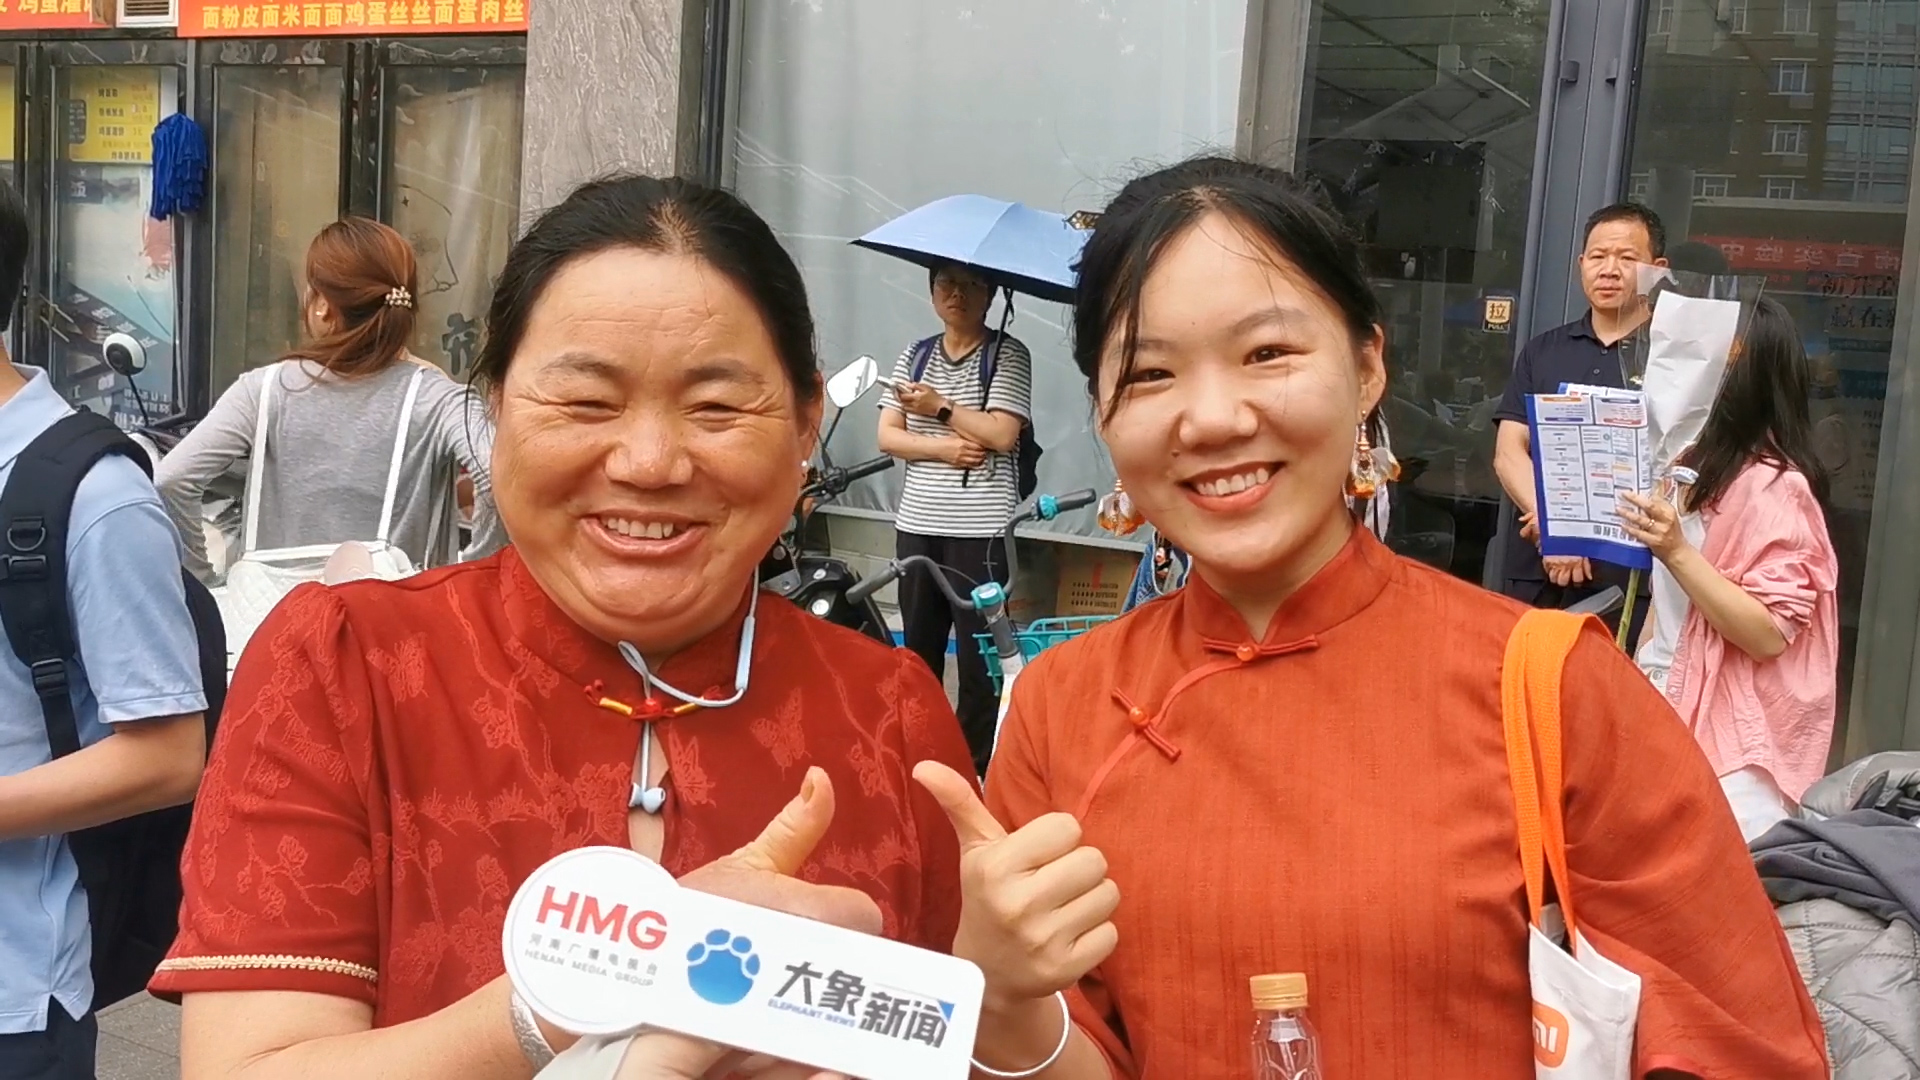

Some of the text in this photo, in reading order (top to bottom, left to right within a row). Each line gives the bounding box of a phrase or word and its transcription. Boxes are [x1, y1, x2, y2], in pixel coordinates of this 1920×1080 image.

[18, 0, 90, 14] 鸡蛋灌
[1489, 303, 1506, 319] 拉
[536, 885, 668, 951] HMG
[525, 949, 654, 987] HENAN MEDIA GROUP
[529, 933, 658, 976] 河南广播电视台
[767, 998, 856, 1028] ELEPHANT NEWS
[774, 961, 954, 1049] 大象新闻
